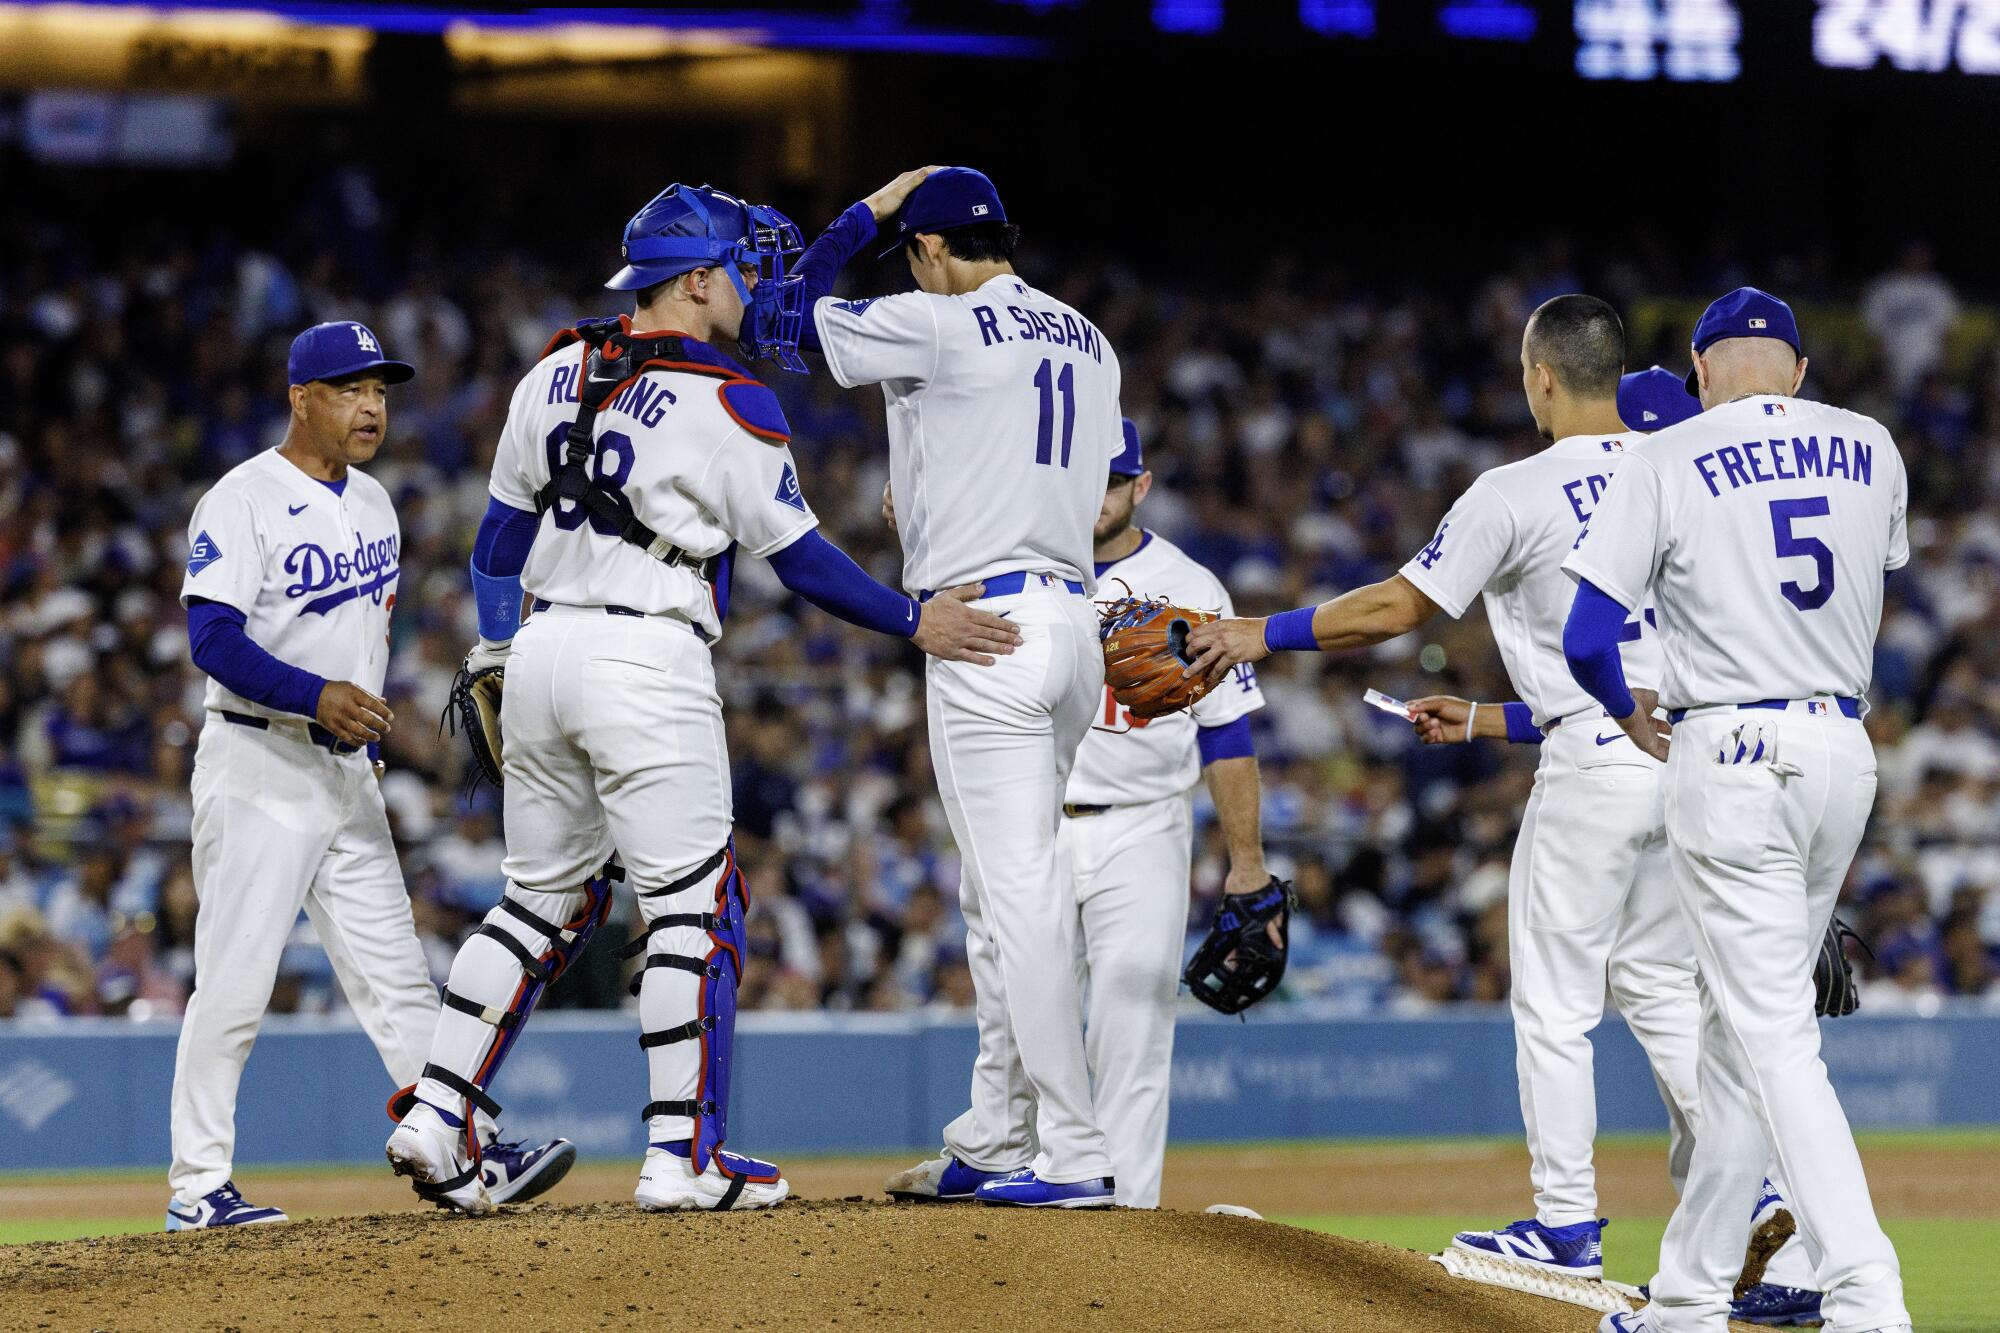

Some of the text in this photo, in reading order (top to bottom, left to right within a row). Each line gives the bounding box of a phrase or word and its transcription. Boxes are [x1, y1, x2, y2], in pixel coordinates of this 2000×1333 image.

[351, 325, 377, 352] LA
[972, 305, 1102, 364] R. SASAKI
[547, 363, 677, 429] RUING
[1033, 358, 1076, 469] 11
[1693, 435, 1872, 498] FREEMAN
[1768, 495, 1835, 612] 5
